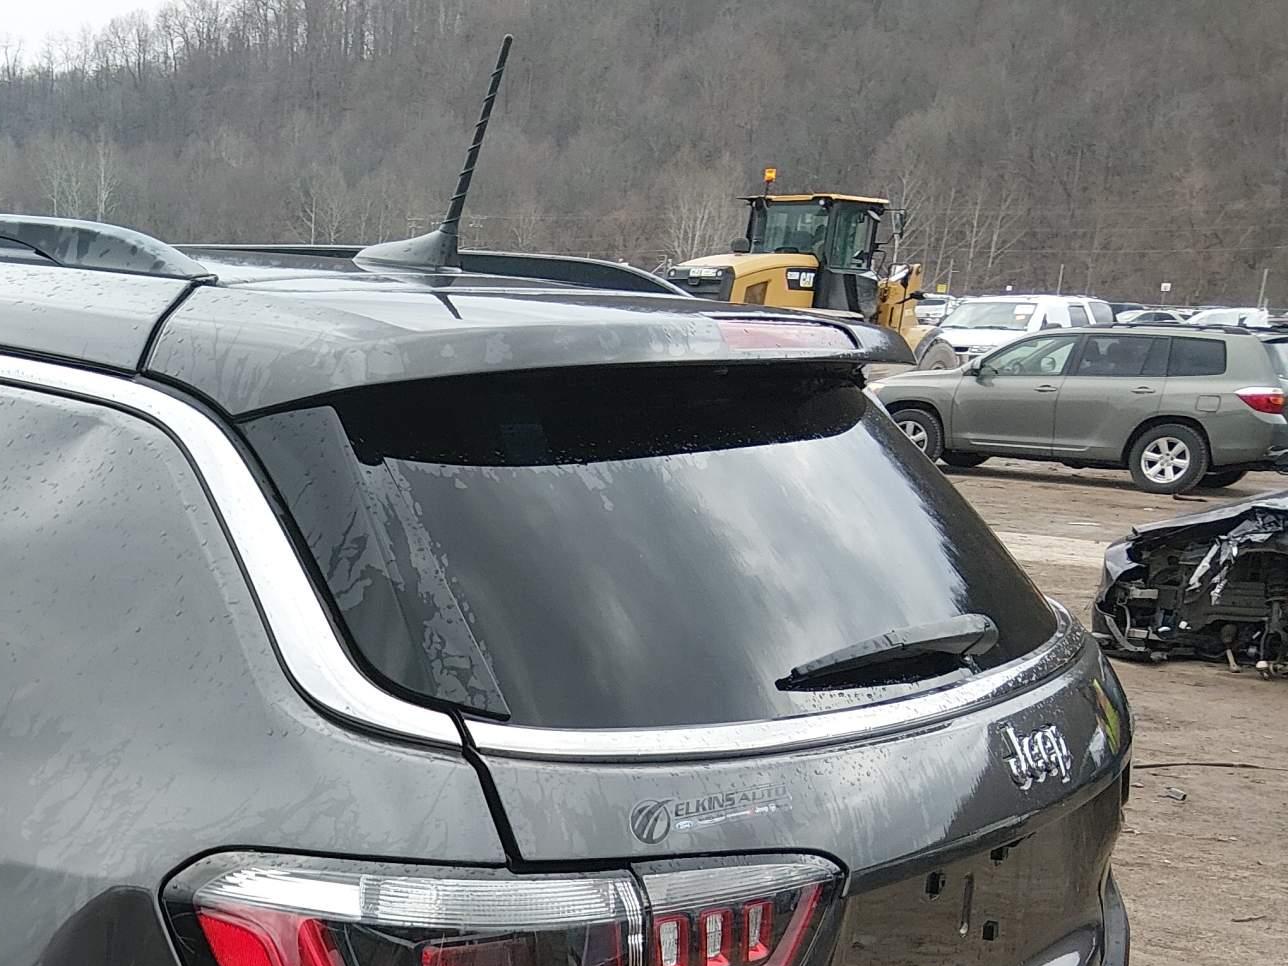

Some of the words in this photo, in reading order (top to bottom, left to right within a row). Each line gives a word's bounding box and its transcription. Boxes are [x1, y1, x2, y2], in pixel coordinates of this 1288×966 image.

[799, 271, 815, 288] CAT
[999, 723, 1073, 791] Jeep
[674, 791, 736, 817] ELKINS
